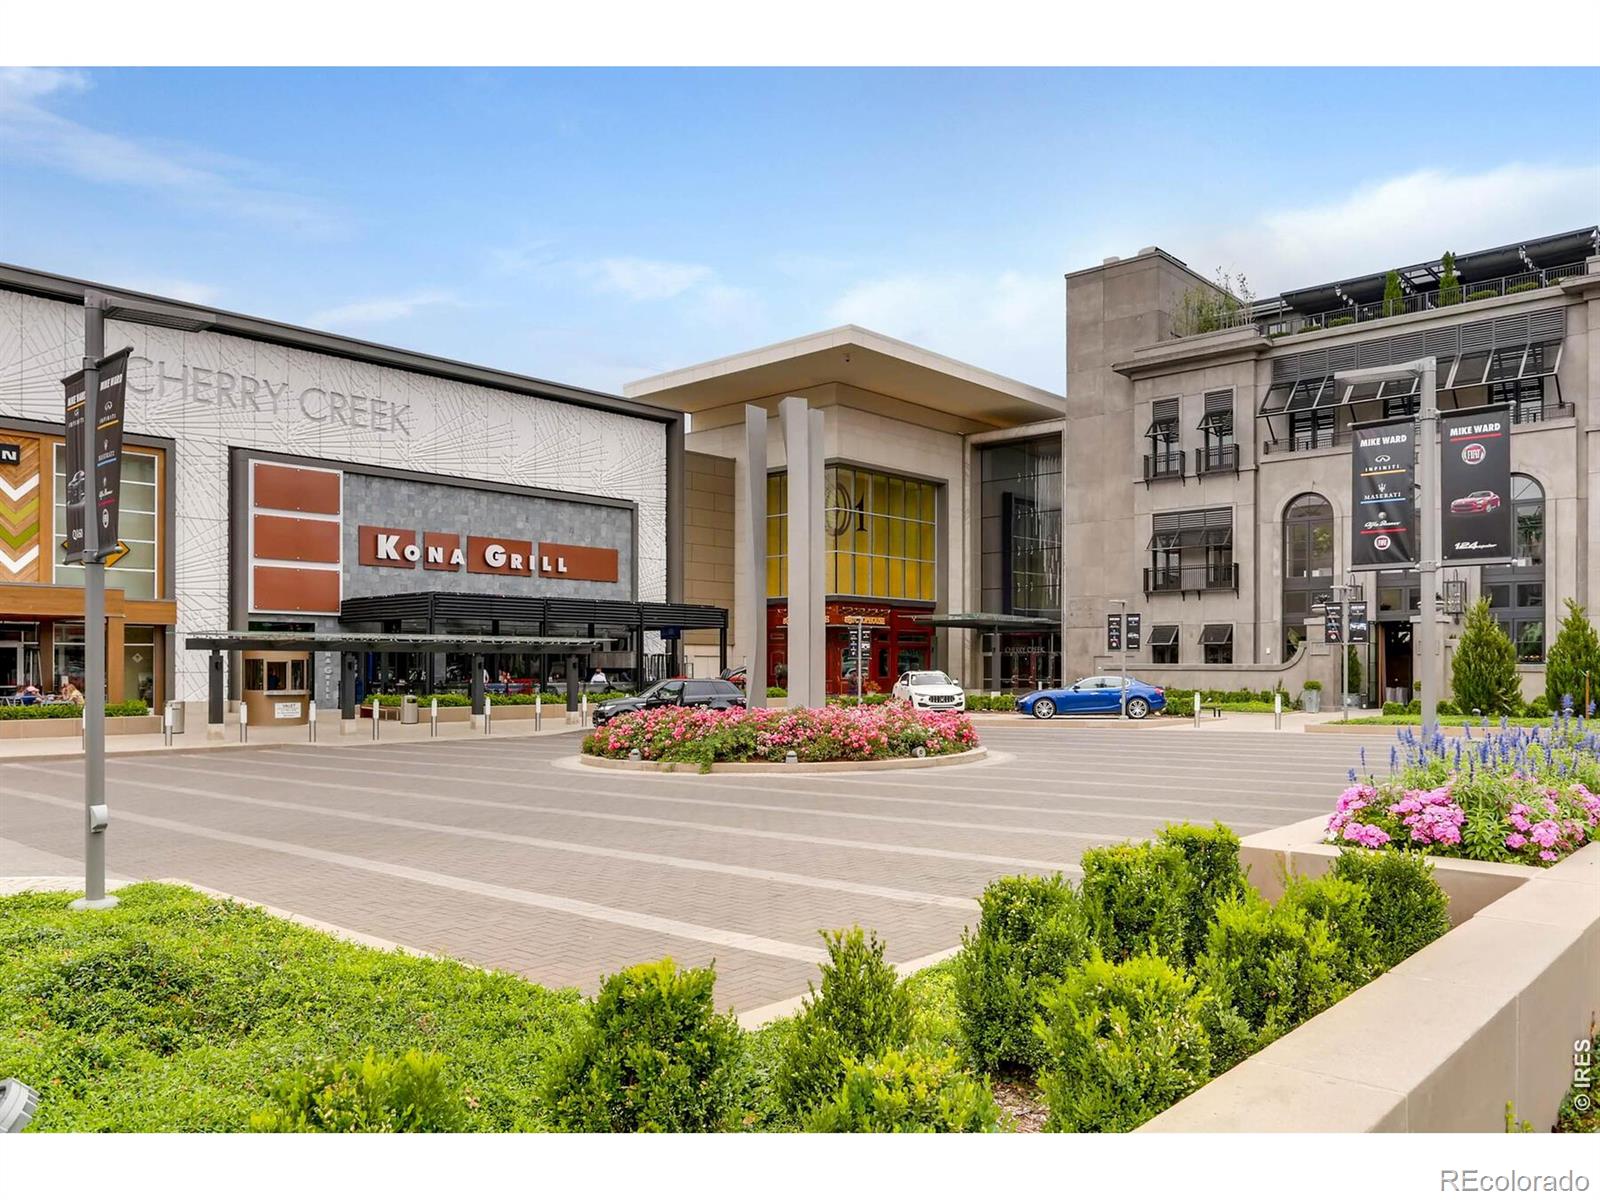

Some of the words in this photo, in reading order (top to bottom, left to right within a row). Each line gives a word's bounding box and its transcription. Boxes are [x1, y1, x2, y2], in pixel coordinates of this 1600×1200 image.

[127, 356, 288, 414] CHERRY
[299, 387, 411, 435] CREEK
[1450, 426, 1472, 436] MIKE
[1474, 422, 1501, 433] WARD
[1360, 437, 1381, 447] MIKE
[1382, 434, 1407, 444] WARD
[1365, 464, 1400, 472] INFINITI
[1364, 492, 1401, 500] MASERATI
[375, 534, 466, 565] KONA
[484, 544, 568, 573] GRILL
